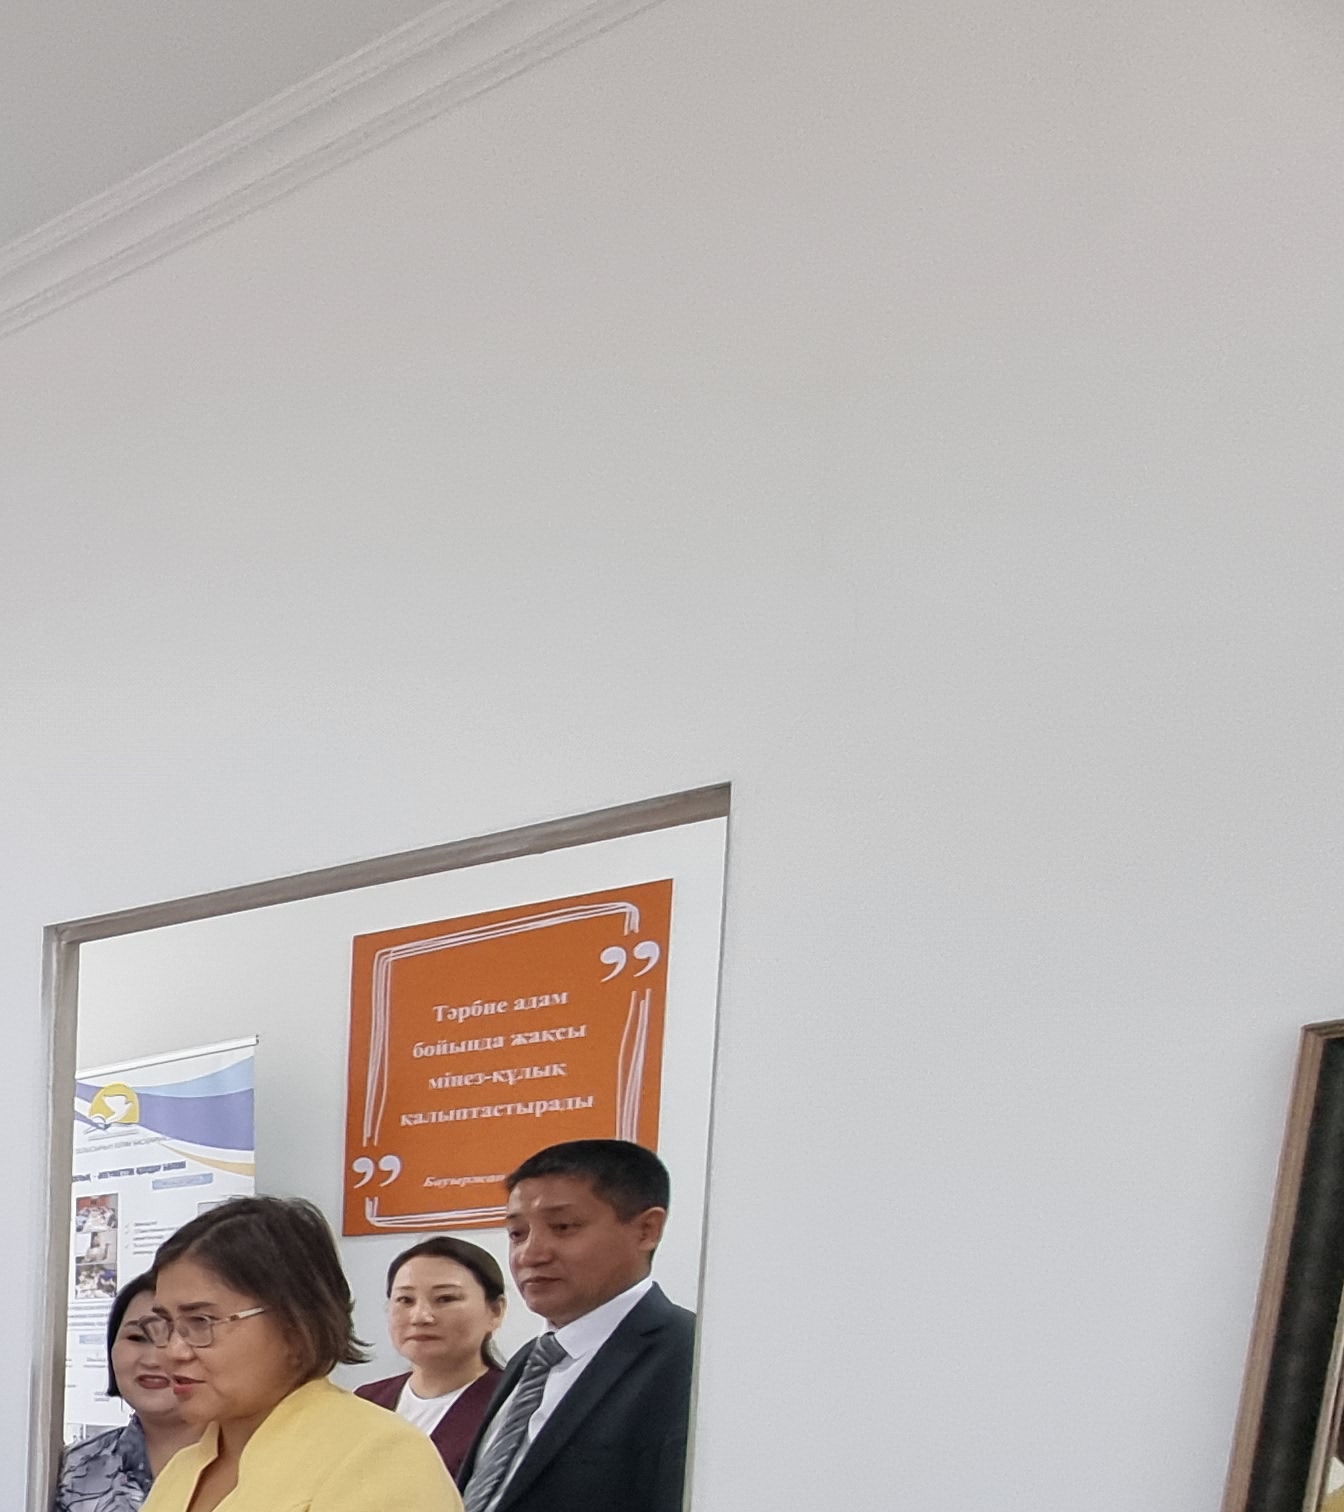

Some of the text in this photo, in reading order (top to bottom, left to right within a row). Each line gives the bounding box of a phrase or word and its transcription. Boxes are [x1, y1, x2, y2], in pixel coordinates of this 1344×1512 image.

[432, 991, 570, 1024] Тәрбие адам
[412, 1035, 505, 1059] бойында
